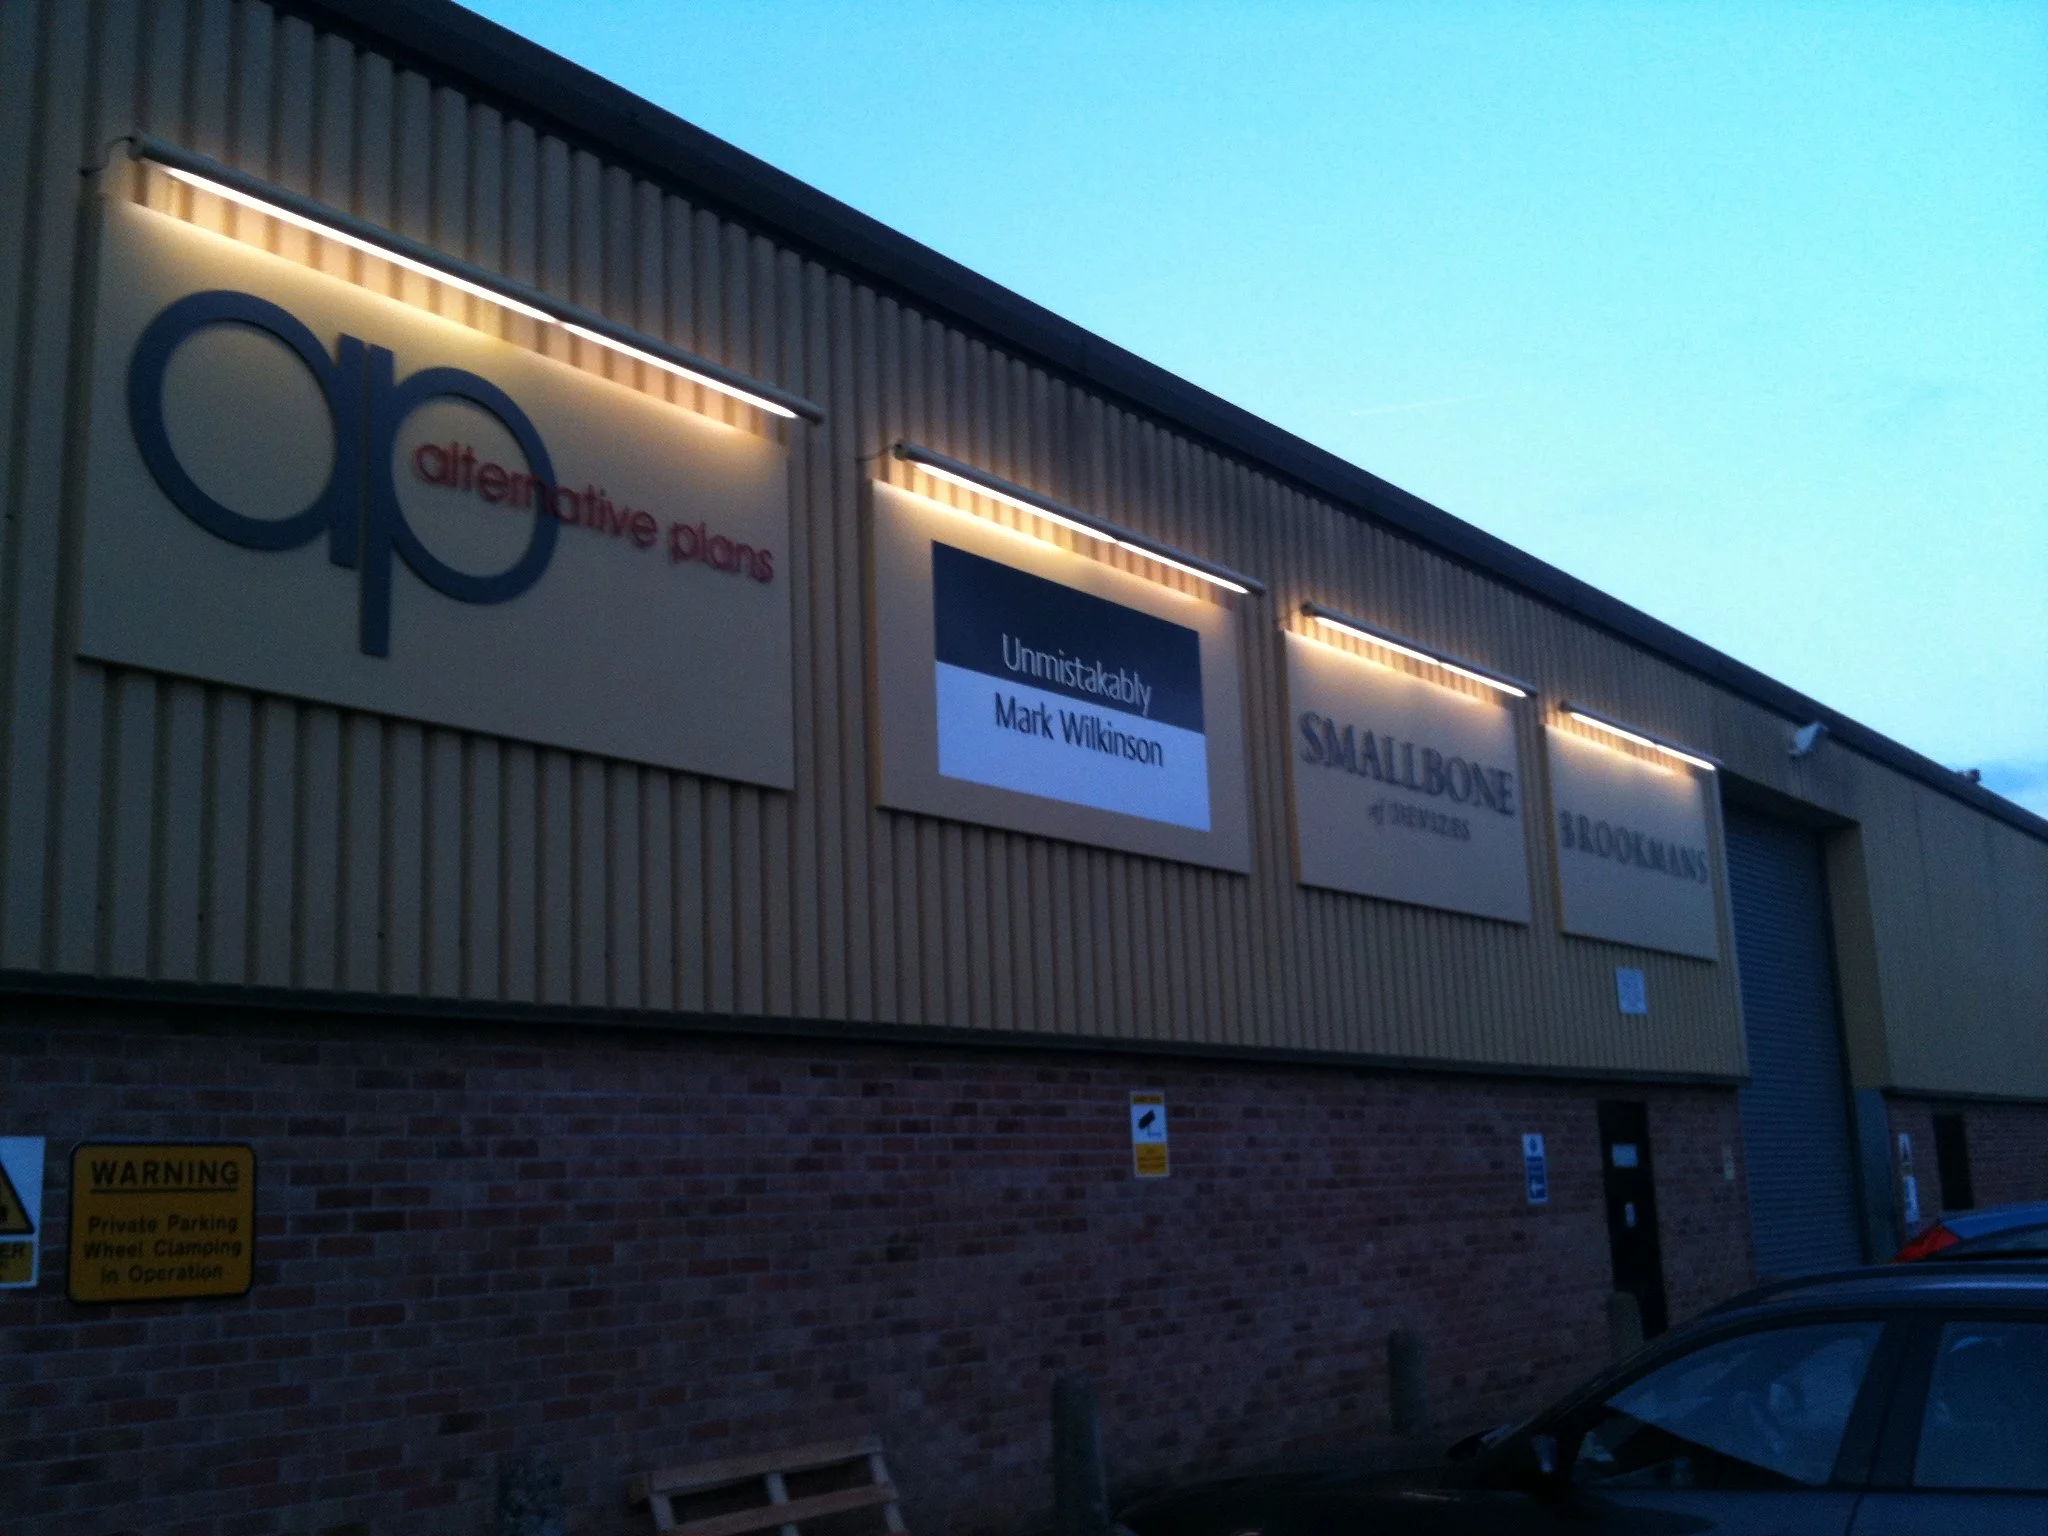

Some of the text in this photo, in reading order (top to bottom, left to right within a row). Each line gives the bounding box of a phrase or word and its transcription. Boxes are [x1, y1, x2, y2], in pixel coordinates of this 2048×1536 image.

[414, 440, 774, 584] alternative plans
[1001, 632, 1153, 718] Unmistakably
[994, 691, 1164, 768] Mark Wilkinson
[1301, 711, 1515, 817] SMALLBONE
[1560, 809, 1709, 885] BROOKMANS
[91, 1159, 240, 1186] WARNING
[83, 1238, 242, 1260] Wheel Clamping
[88, 1213, 239, 1235] Private Parking
[128, 1264, 224, 1286] Operation
